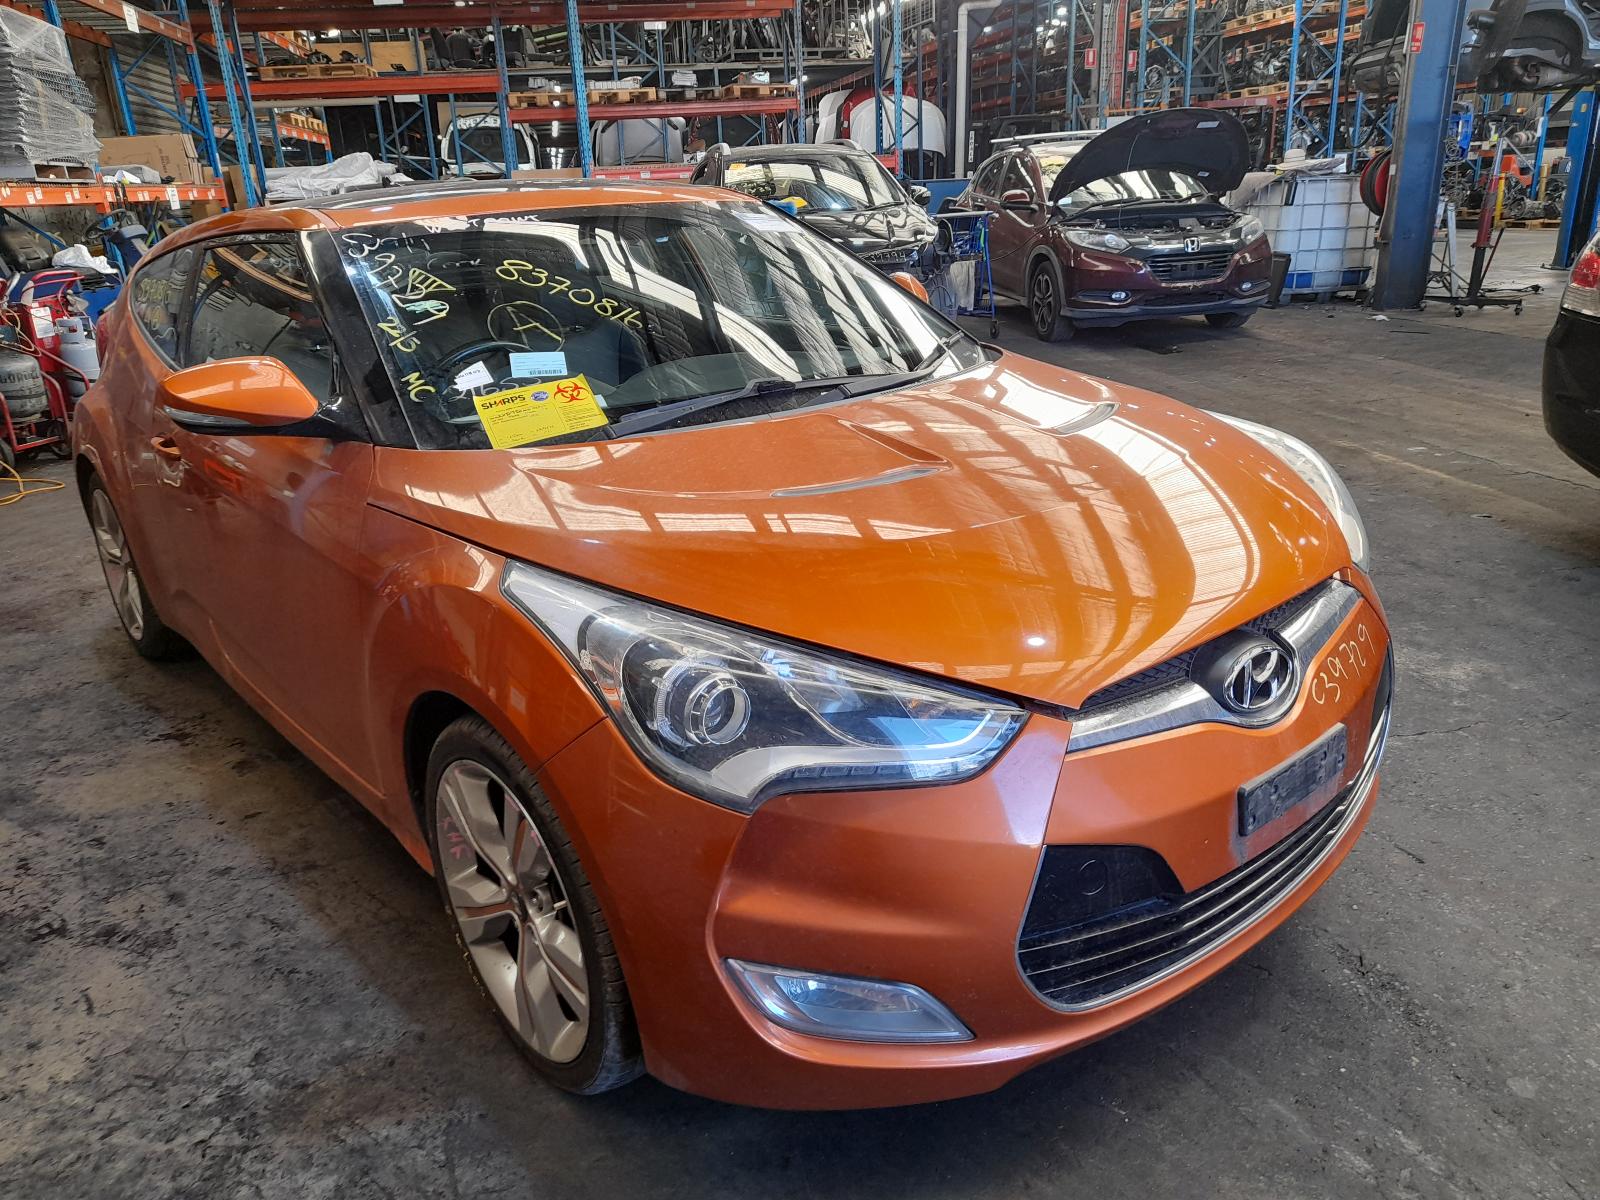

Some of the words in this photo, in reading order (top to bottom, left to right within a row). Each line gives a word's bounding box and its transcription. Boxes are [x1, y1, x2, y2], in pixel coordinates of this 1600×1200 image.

[495, 259, 644, 330] 8370816
[400, 371, 436, 403] MC
[481, 394, 526, 410] SHARPS
